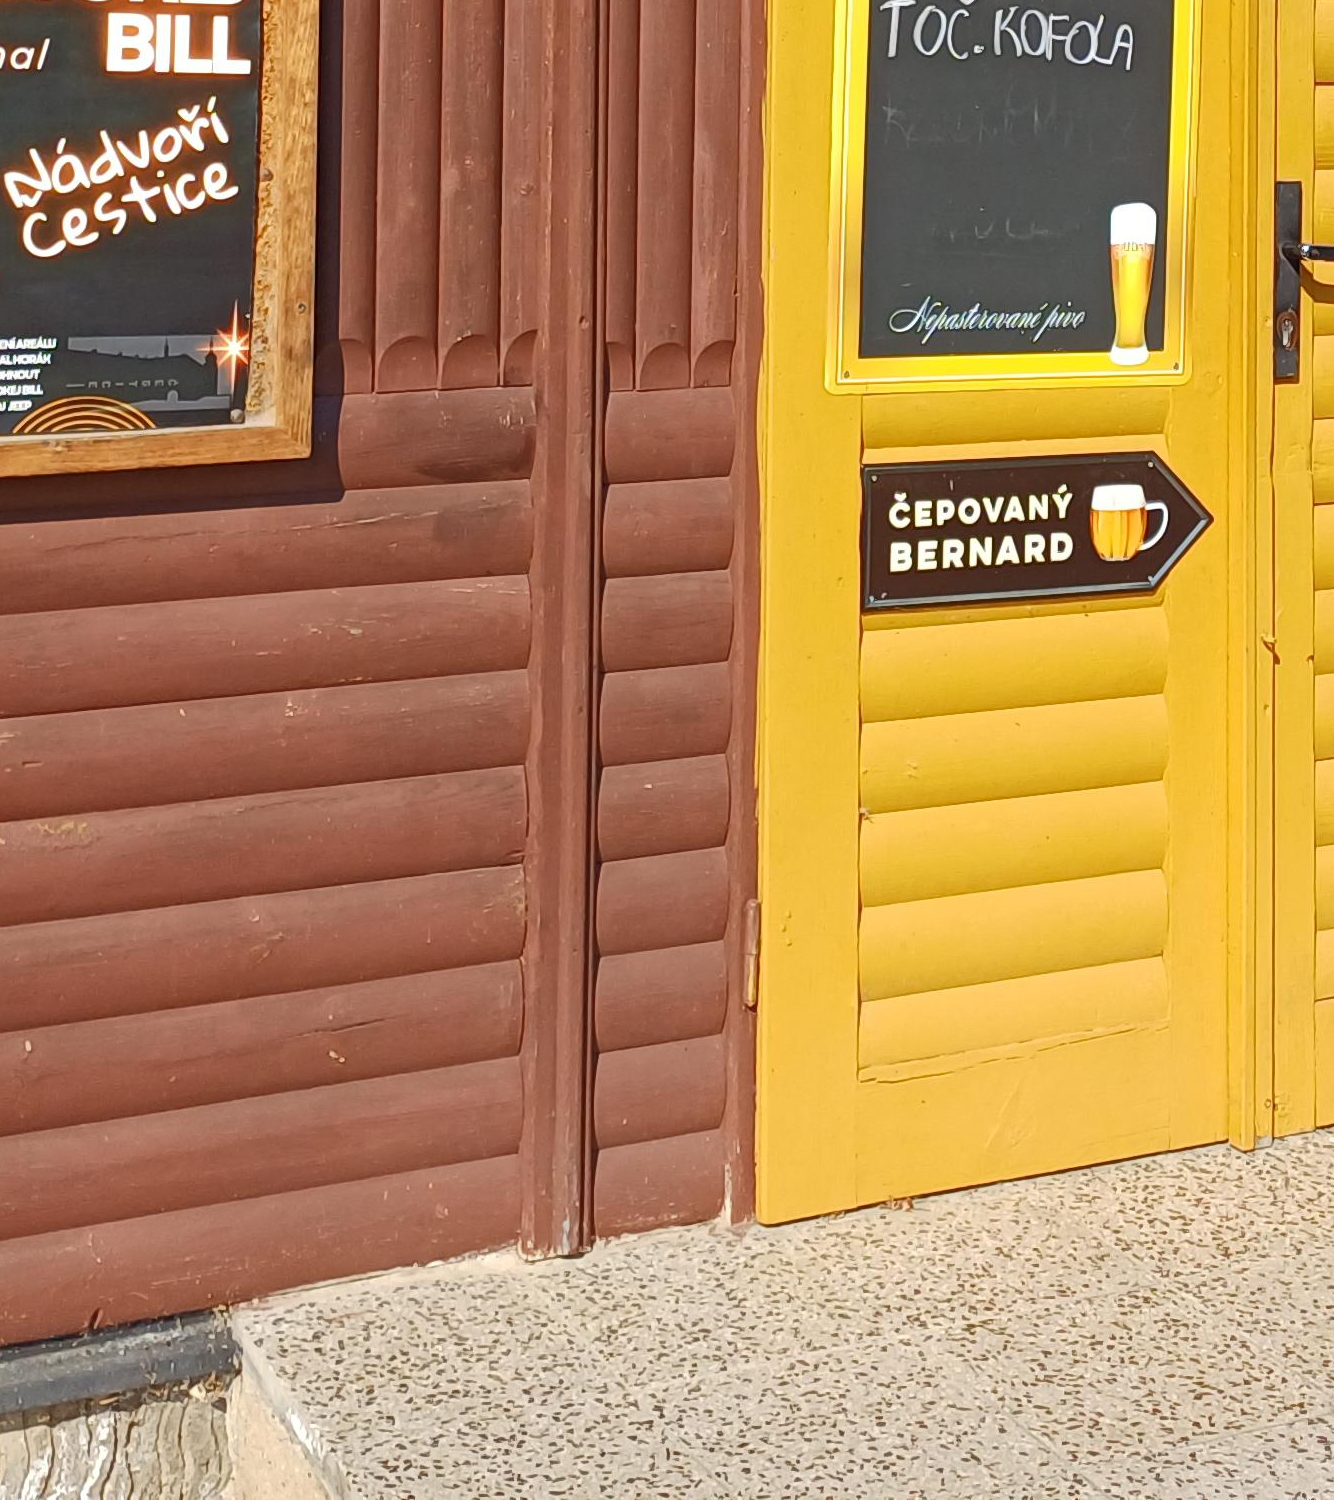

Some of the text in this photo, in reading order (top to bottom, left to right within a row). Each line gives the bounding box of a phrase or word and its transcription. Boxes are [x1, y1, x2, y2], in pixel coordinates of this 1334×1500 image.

[105, 11, 252, 75] BILL
[993, 6, 1135, 72] KOFOLA
[3, 95, 231, 209] Nádvoří
[21, 160, 240, 258] Cestice
[1033, 300, 1086, 344] pivo
[888, 483, 1074, 529] ČEPOVANÝ
[889, 532, 1074, 573] BERNARD
